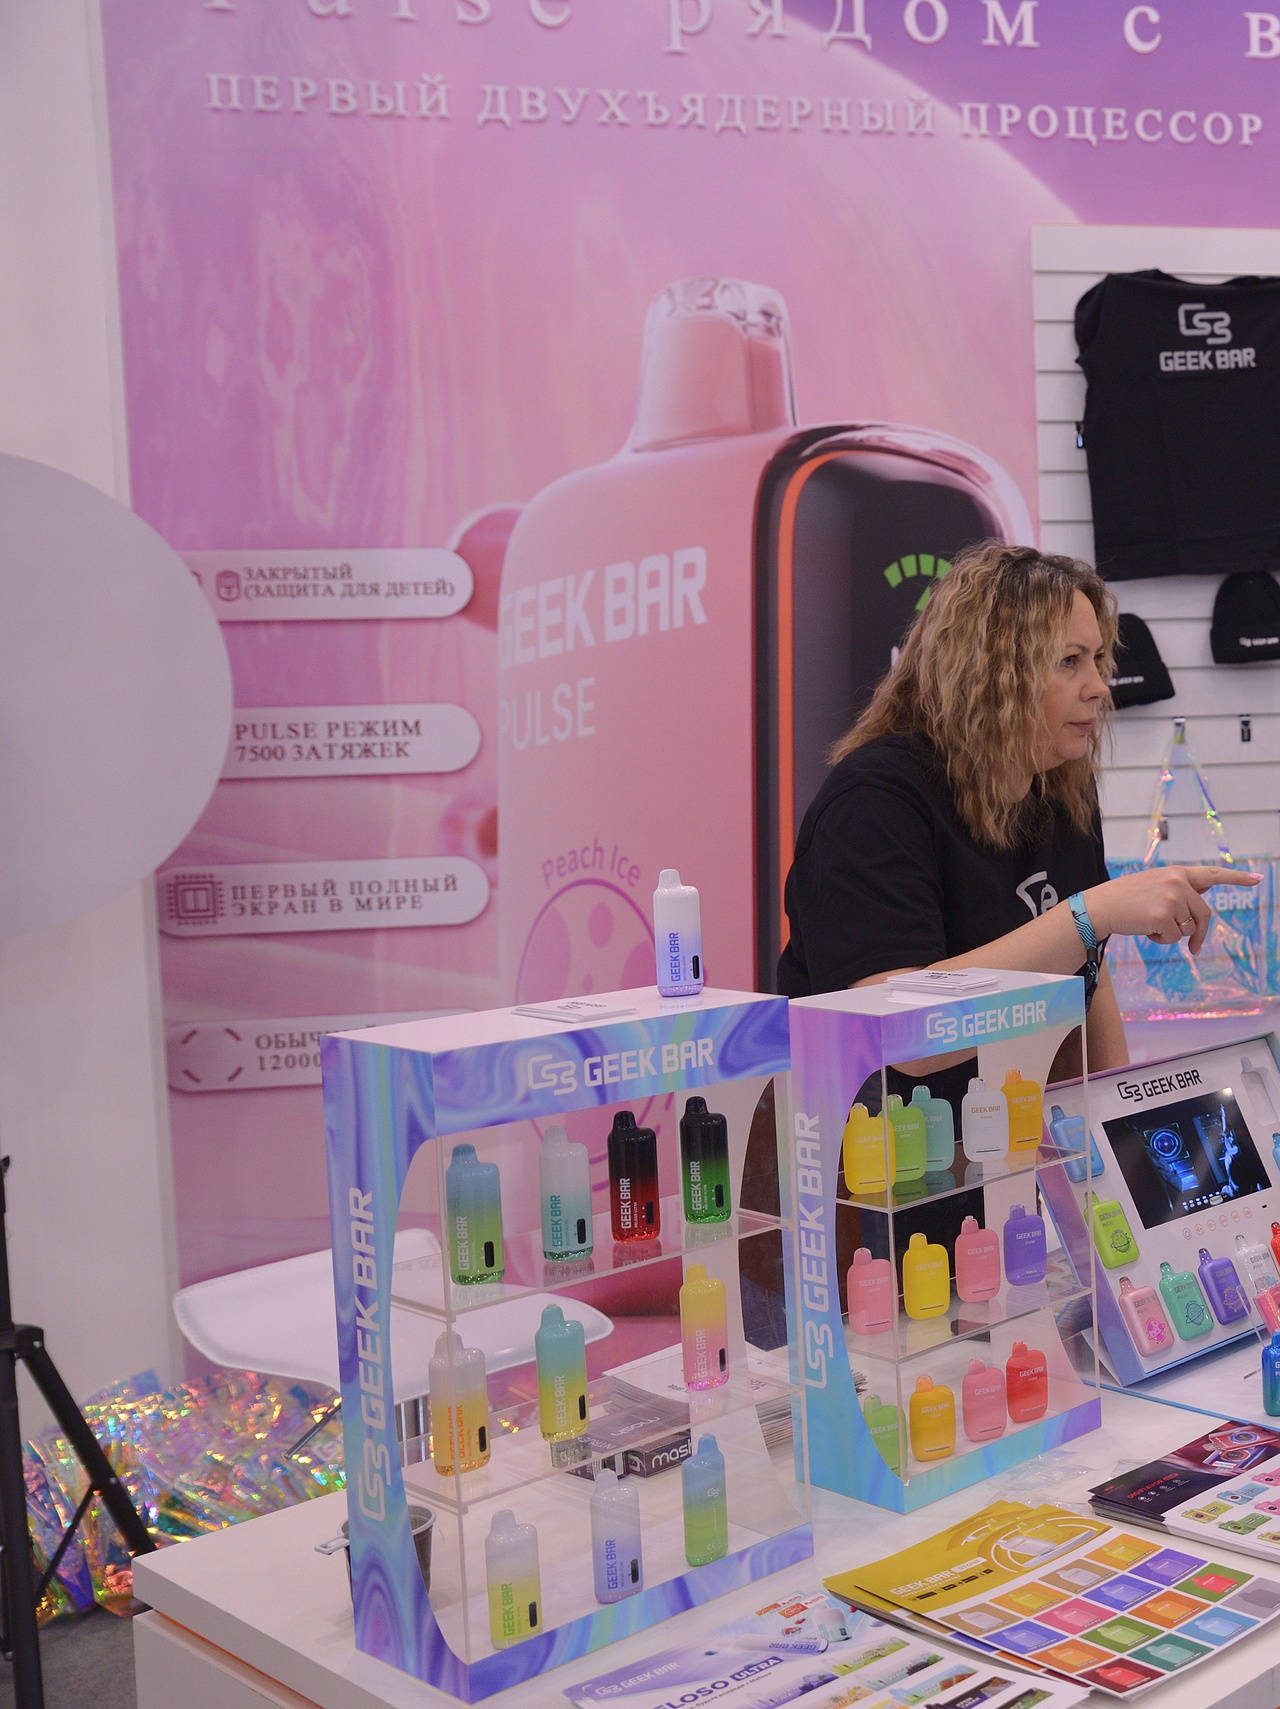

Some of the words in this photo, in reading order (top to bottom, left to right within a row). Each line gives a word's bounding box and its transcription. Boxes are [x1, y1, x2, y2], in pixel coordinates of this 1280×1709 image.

[208, 70, 453, 122] ПЕРВЫЙ
[477, 82, 936, 135] ДВУХЪЯДЕРНЫЙ
[960, 102, 1264, 148] ПРОЦЕССОР
[1159, 351, 1211, 372] GEEK
[1217, 348, 1256, 370] BAR
[243, 563, 353, 581] ЗАКРЫТЫЙ
[243, 582, 335, 599] (ЗАЩИТА
[339, 582, 380, 598] ДЛЯ
[384, 579, 456, 598] ДЕТЕЙ)
[603, 546, 708, 643] BAR
[234, 721, 319, 742] PULSE
[326, 719, 423, 740] РЕЖИМ
[235, 743, 286, 763] 7500
[292, 740, 411, 761] ЗАТЯЖЕК
[541, 836, 605, 889] Peach
[609, 840, 642, 888] Ice
[231, 877, 338, 901] ПЕРВЫЙ
[348, 874, 459, 896] ПОЛНЫЙ
[231, 899, 318, 918] ЭКРАН
[329, 898, 343, 914] В
[355, 895, 424, 912] МИРЕ
[669, 932, 680, 953] BAR
[670, 954, 681, 982] GEEK
[962, 1004, 1010, 1038] GEEK
[1012, 1000, 1046, 1027] BAR
[583, 1051, 657, 1088] GEEK
[661, 1037, 714, 1075] BAR
[1143, 1072, 1177, 1097] GEEK
[1178, 1068, 1202, 1089] BAR
[971, 1106, 988, 1114] GEEK
[989, 1105, 1000, 1113] BAR
[894, 1124, 907, 1132] EEK
[794, 1112, 823, 1197] BAR
[690, 1161, 700, 1182] BAR
[619, 1178, 631, 1200] BAR
[691, 1183, 702, 1210] GEEK
[550, 1195, 561, 1217] BAR
[620, 1201, 632, 1229] GEEK
[348, 1187, 379, 1290] BAR
[456, 1216, 468, 1239] BAR
[552, 1219, 563, 1248] GEEK
[1016, 1231, 1031, 1240] GEEK
[1031, 1230, 1042, 1238] BAR
[458, 1242, 470, 1271] GEEK
[799, 1201, 829, 1313] GEEK
[695, 1329, 705, 1351] BAR
[354, 1295, 387, 1432] GEEK
[697, 1353, 708, 1378] GEEK
[555, 1375, 565, 1397] BAR
[556, 1398, 567, 1428] GEEK
[605, 1538, 616, 1562] BAR
[608, 1563, 619, 1590] GEEK
[890, 1580, 924, 1595] GEEK
[924, 1570, 954, 1584] BAR
[502, 1583, 513, 1606] BAR
[503, 1608, 514, 1636] GEEK
[621, 1671, 654, 1689] GEEK
[653, 1662, 681, 1677] BAR
[734, 1658, 780, 1680] ULTRA
